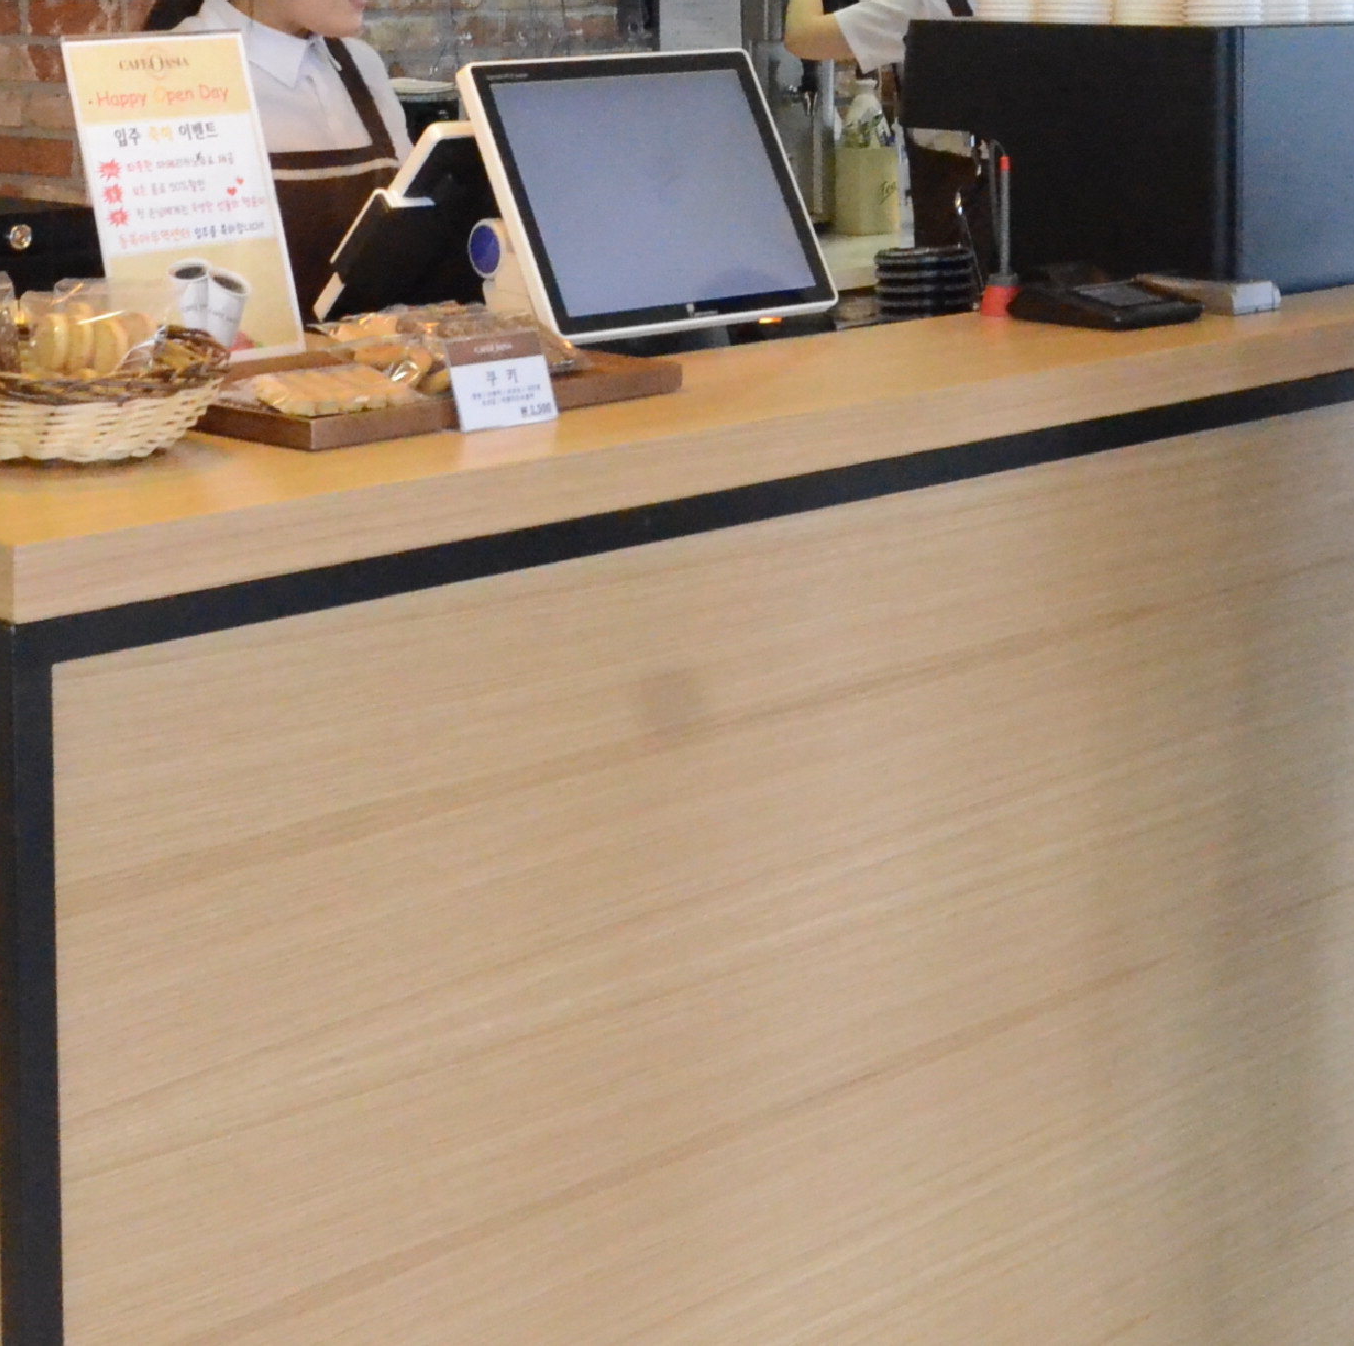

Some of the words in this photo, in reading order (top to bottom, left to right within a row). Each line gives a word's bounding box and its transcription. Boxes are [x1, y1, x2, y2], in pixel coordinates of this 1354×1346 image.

[96, 90, 147, 108] Happy
[153, 85, 195, 106] Open
[198, 84, 229, 102] Day
[114, 129, 141, 146] 입주
[178, 121, 219, 142] 이벤트
